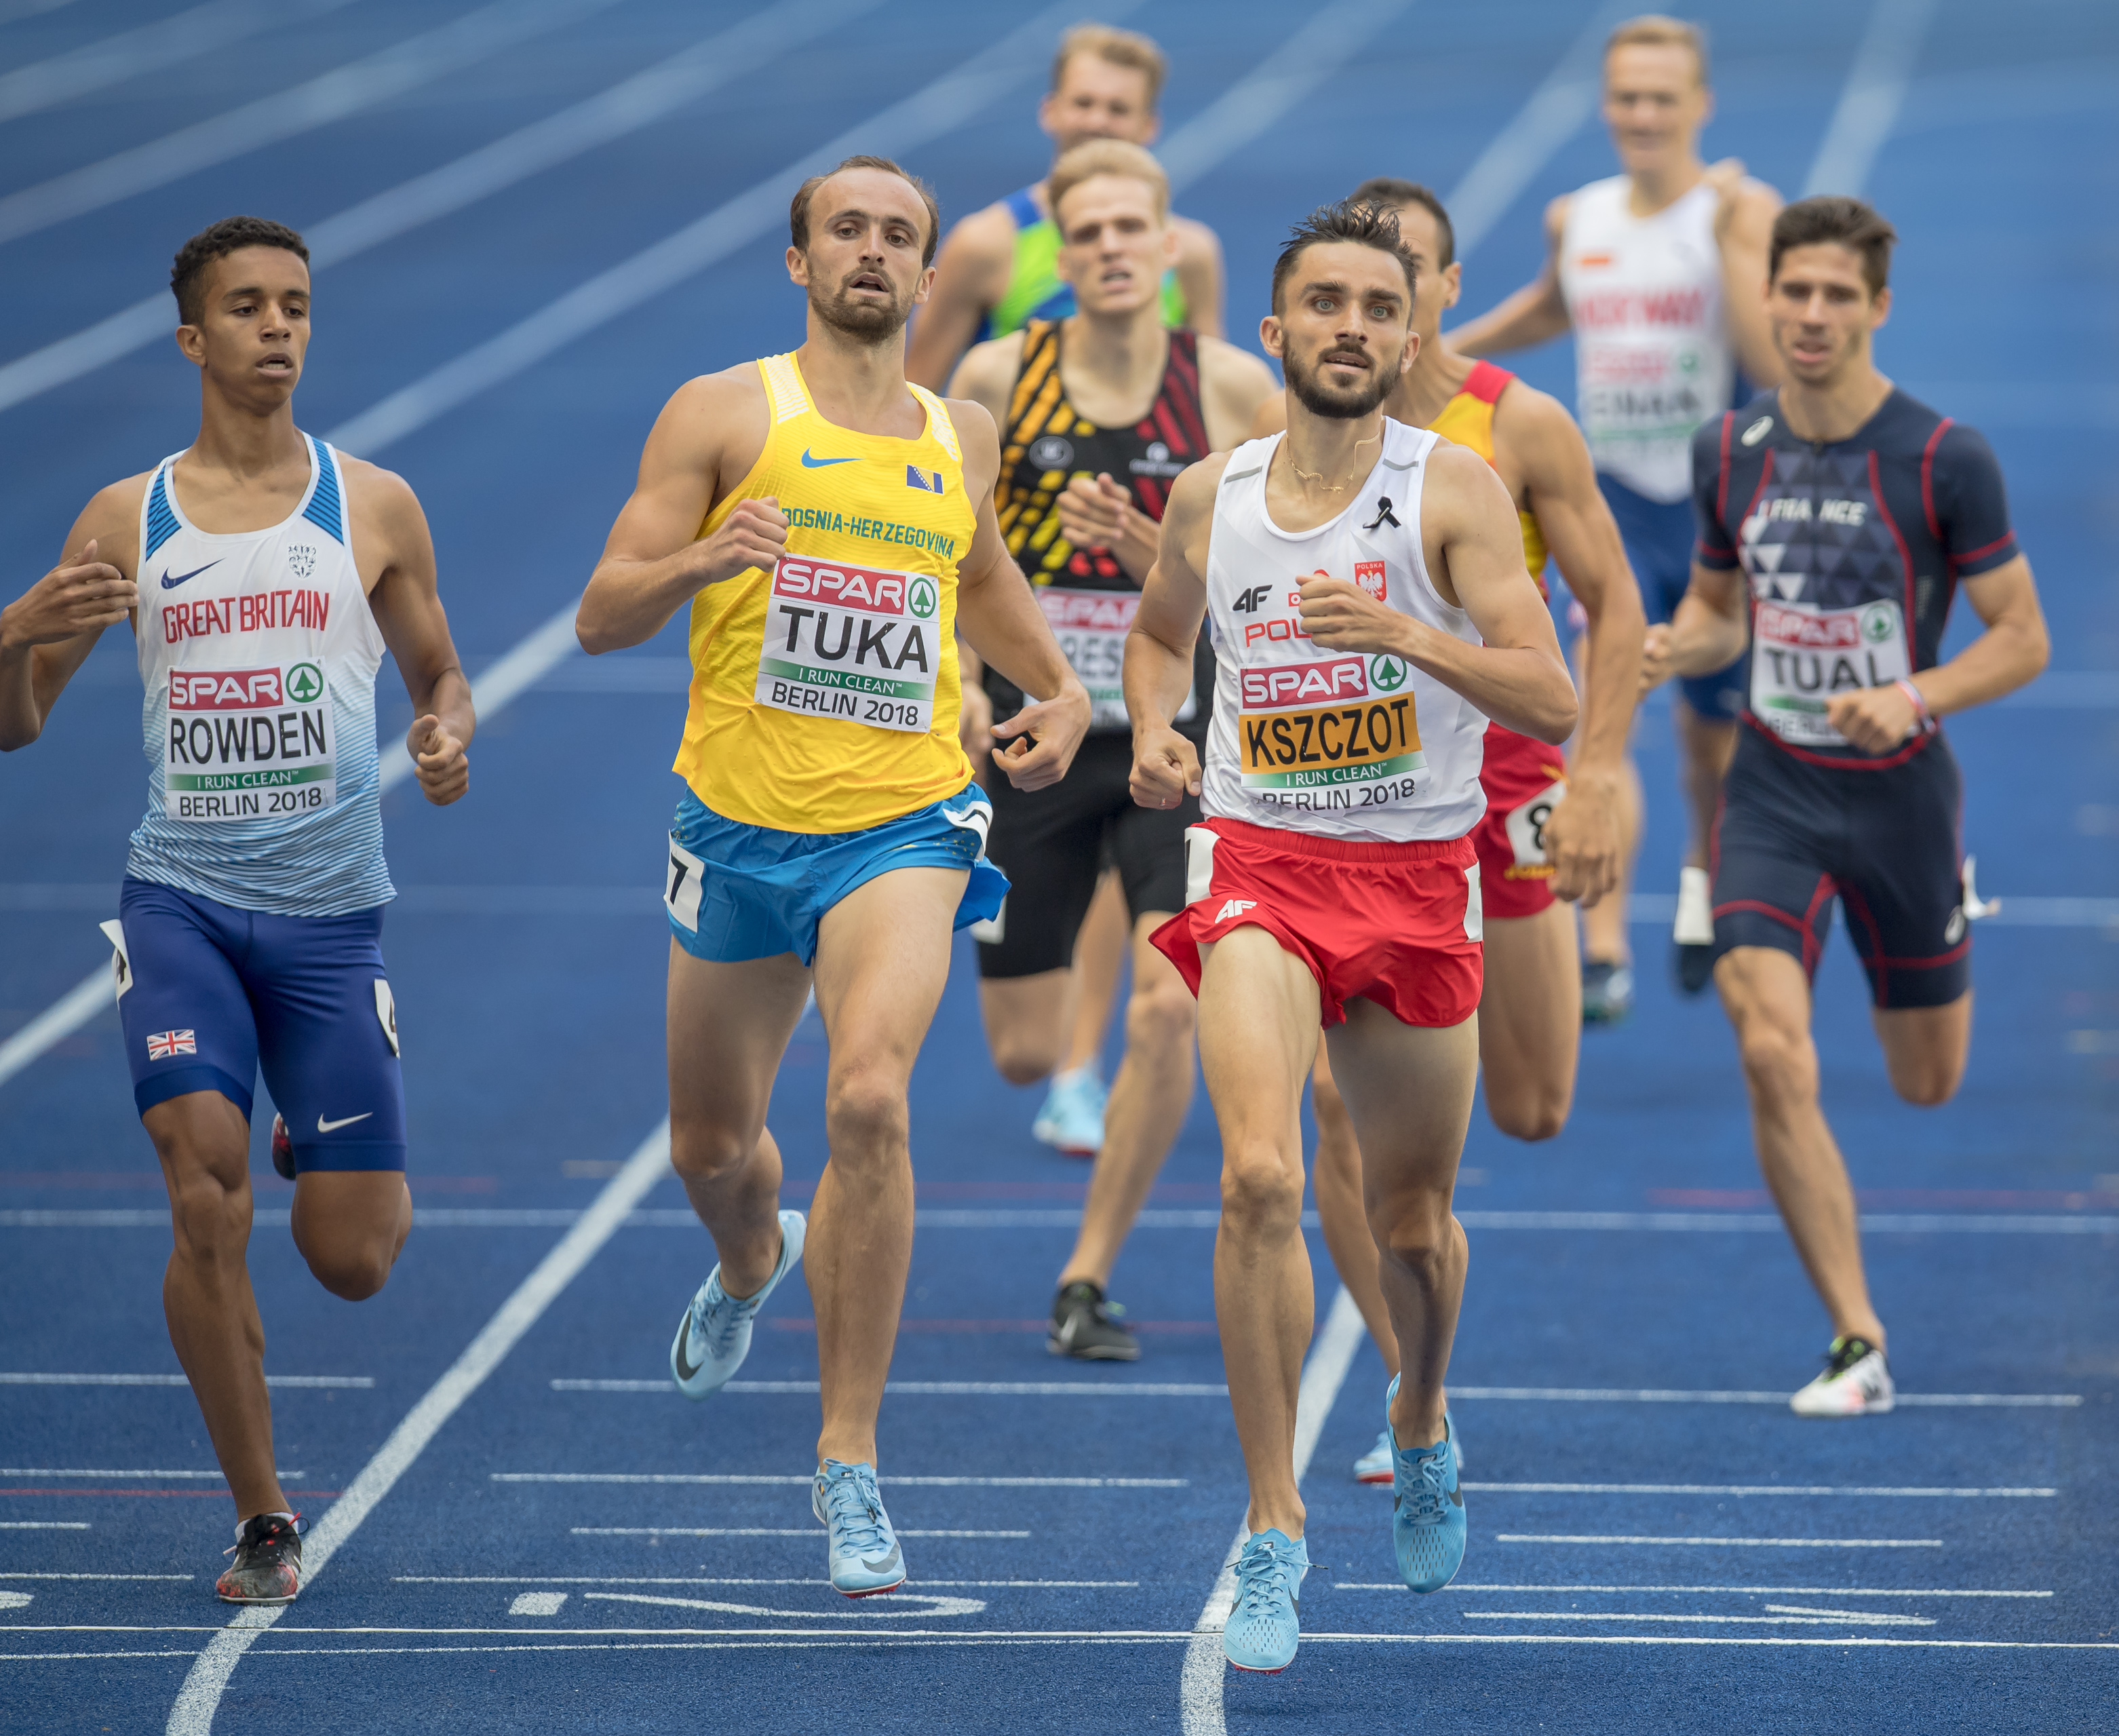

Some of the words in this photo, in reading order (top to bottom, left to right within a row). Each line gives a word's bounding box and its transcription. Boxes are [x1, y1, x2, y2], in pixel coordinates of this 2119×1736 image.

[781, 507, 954, 560] BOSNIA-HERZEGOVINA
[779, 563, 902, 609] SPAR
[163, 597, 236, 644] GREAT
[239, 589, 329, 631] BRITAIN
[1245, 619, 1313, 647] POL
[779, 604, 929, 673] TUKA
[170, 672, 279, 706] SPAR
[799, 668, 803, 680] I
[807, 670, 842, 687] RUN
[1244, 663, 1364, 703] SPAR
[1764, 649, 1896, 691] TUAL
[772, 682, 857, 716] BERLIN
[864, 699, 918, 726] 2018
[170, 708, 327, 765] ROWDEN
[1246, 698, 1409, 767] KSZCZOT
[197, 777, 201, 788] I
[205, 775, 237, 789] RUN
[1287, 774, 1290, 786] I
[1296, 770, 1329, 786] RUN
[1359, 778, 1416, 807] 2018
[180, 792, 259, 817] BERLIN
[268, 786, 322, 812] 2018
[670, 852, 689, 906] 7
